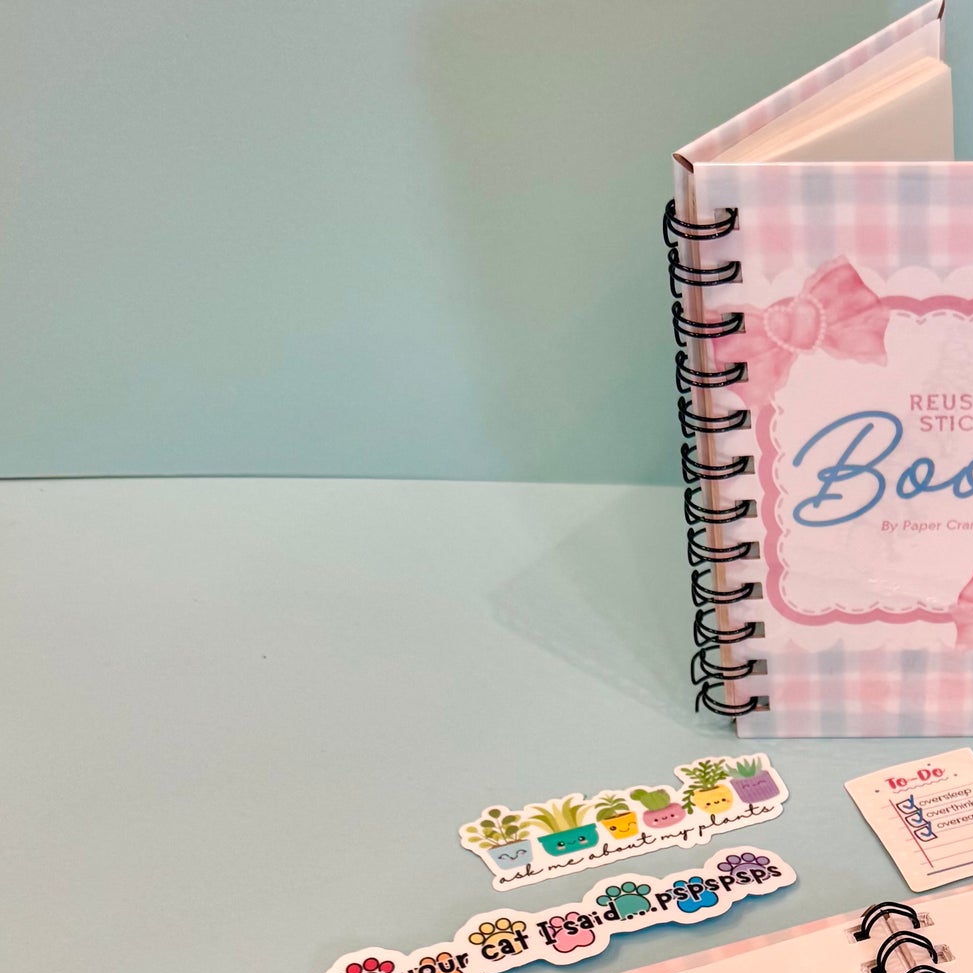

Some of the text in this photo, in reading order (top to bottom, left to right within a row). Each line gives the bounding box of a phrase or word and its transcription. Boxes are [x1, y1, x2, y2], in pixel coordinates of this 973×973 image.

[881, 520, 898, 533] By
[903, 519, 941, 533] Paper
[885, 767, 946, 790] To-Do
[919, 787, 973, 807] oversleep
[499, 803, 774, 884] ask me about my plants
[481, 930, 529, 961] cat
[537, 921, 557, 946] I
